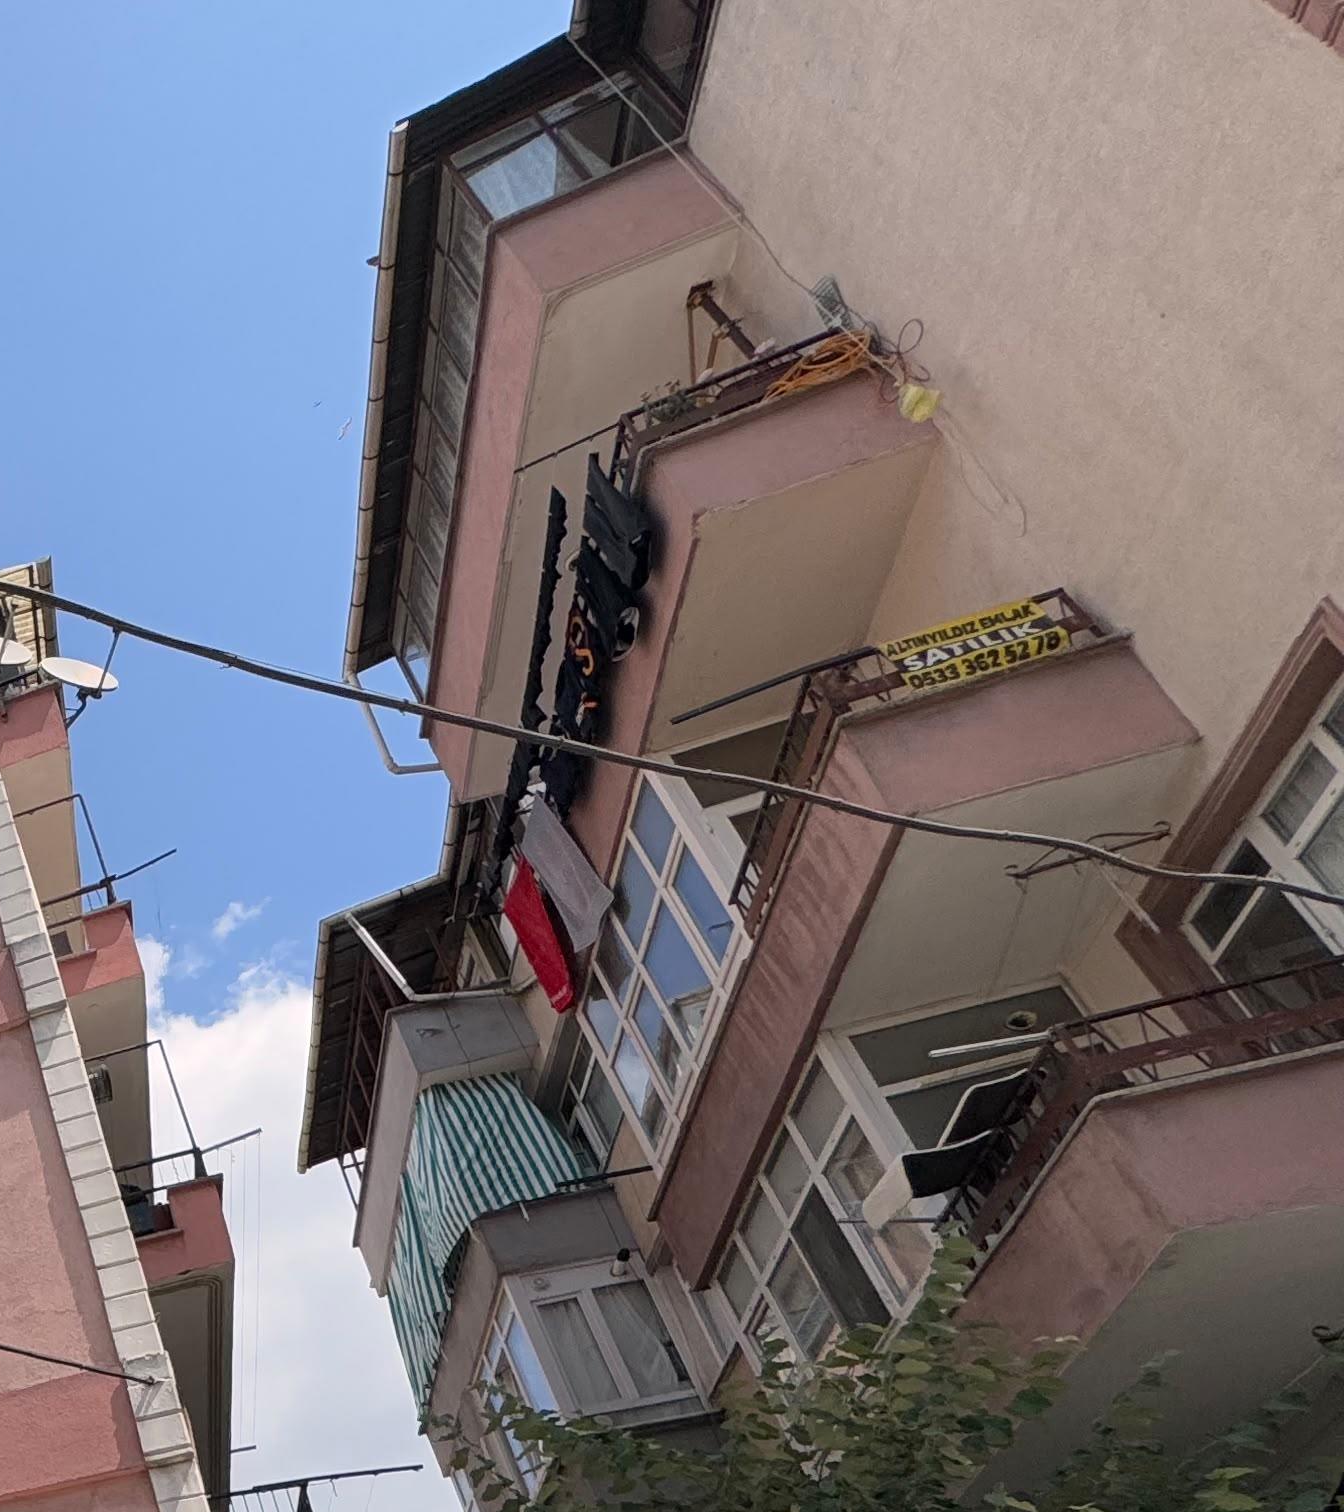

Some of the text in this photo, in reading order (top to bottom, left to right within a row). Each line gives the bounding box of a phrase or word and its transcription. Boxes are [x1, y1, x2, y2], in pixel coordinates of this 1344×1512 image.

[886, 603, 1036, 657] ALTINYILDIZ EMLAK
[902, 621, 1042, 671] SATILIK
[908, 662, 961, 690] 0533
[962, 648, 1002, 676] 362
[1003, 642, 1030, 664] 52
